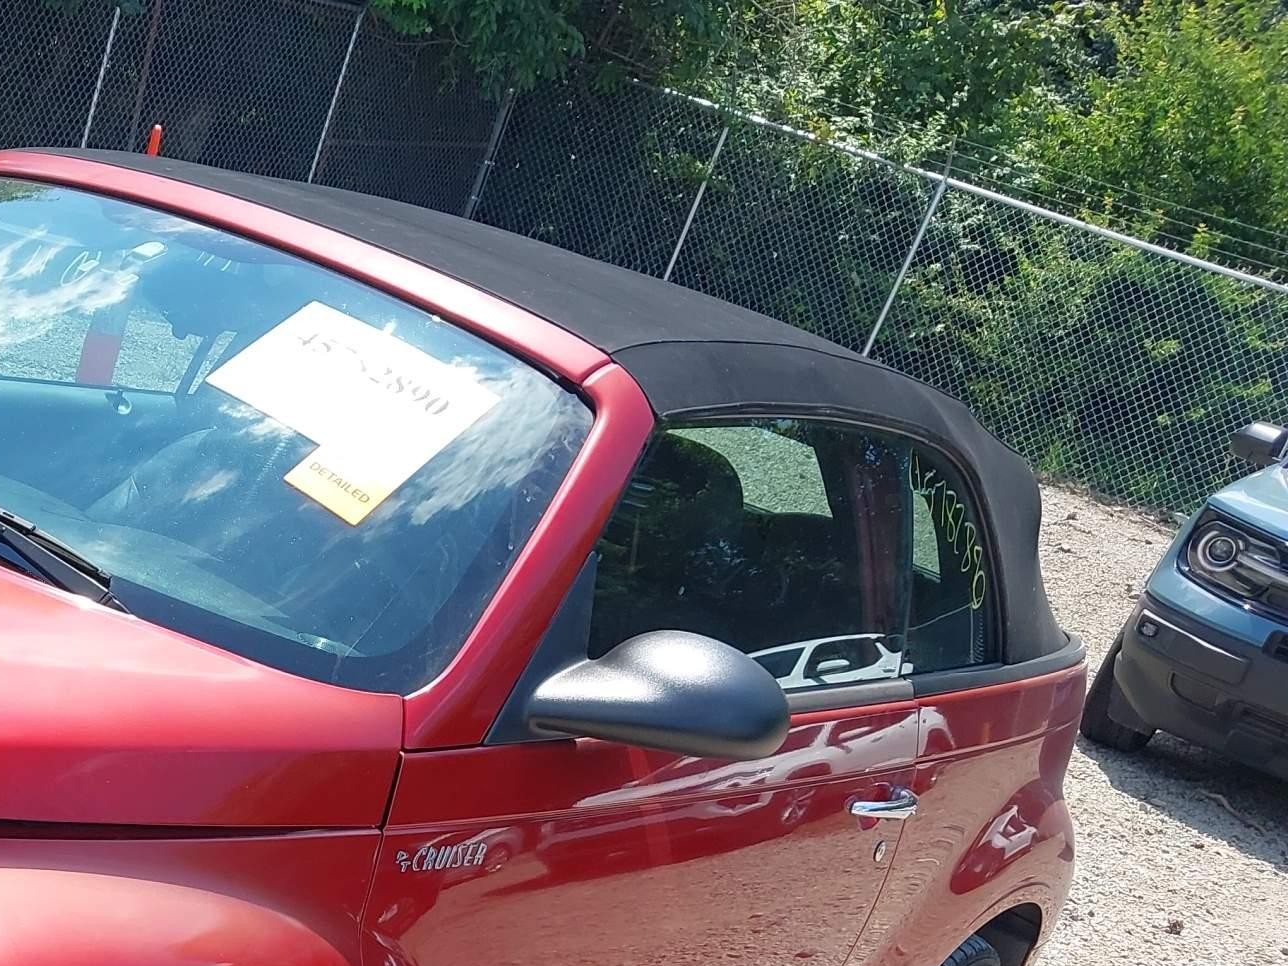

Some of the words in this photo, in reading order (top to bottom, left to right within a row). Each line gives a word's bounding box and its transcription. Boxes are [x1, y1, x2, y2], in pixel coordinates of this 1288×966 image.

[297, 332, 450, 416] 452890
[309, 460, 371, 504] DETAILED
[412, 842, 488, 872] CRUISER
